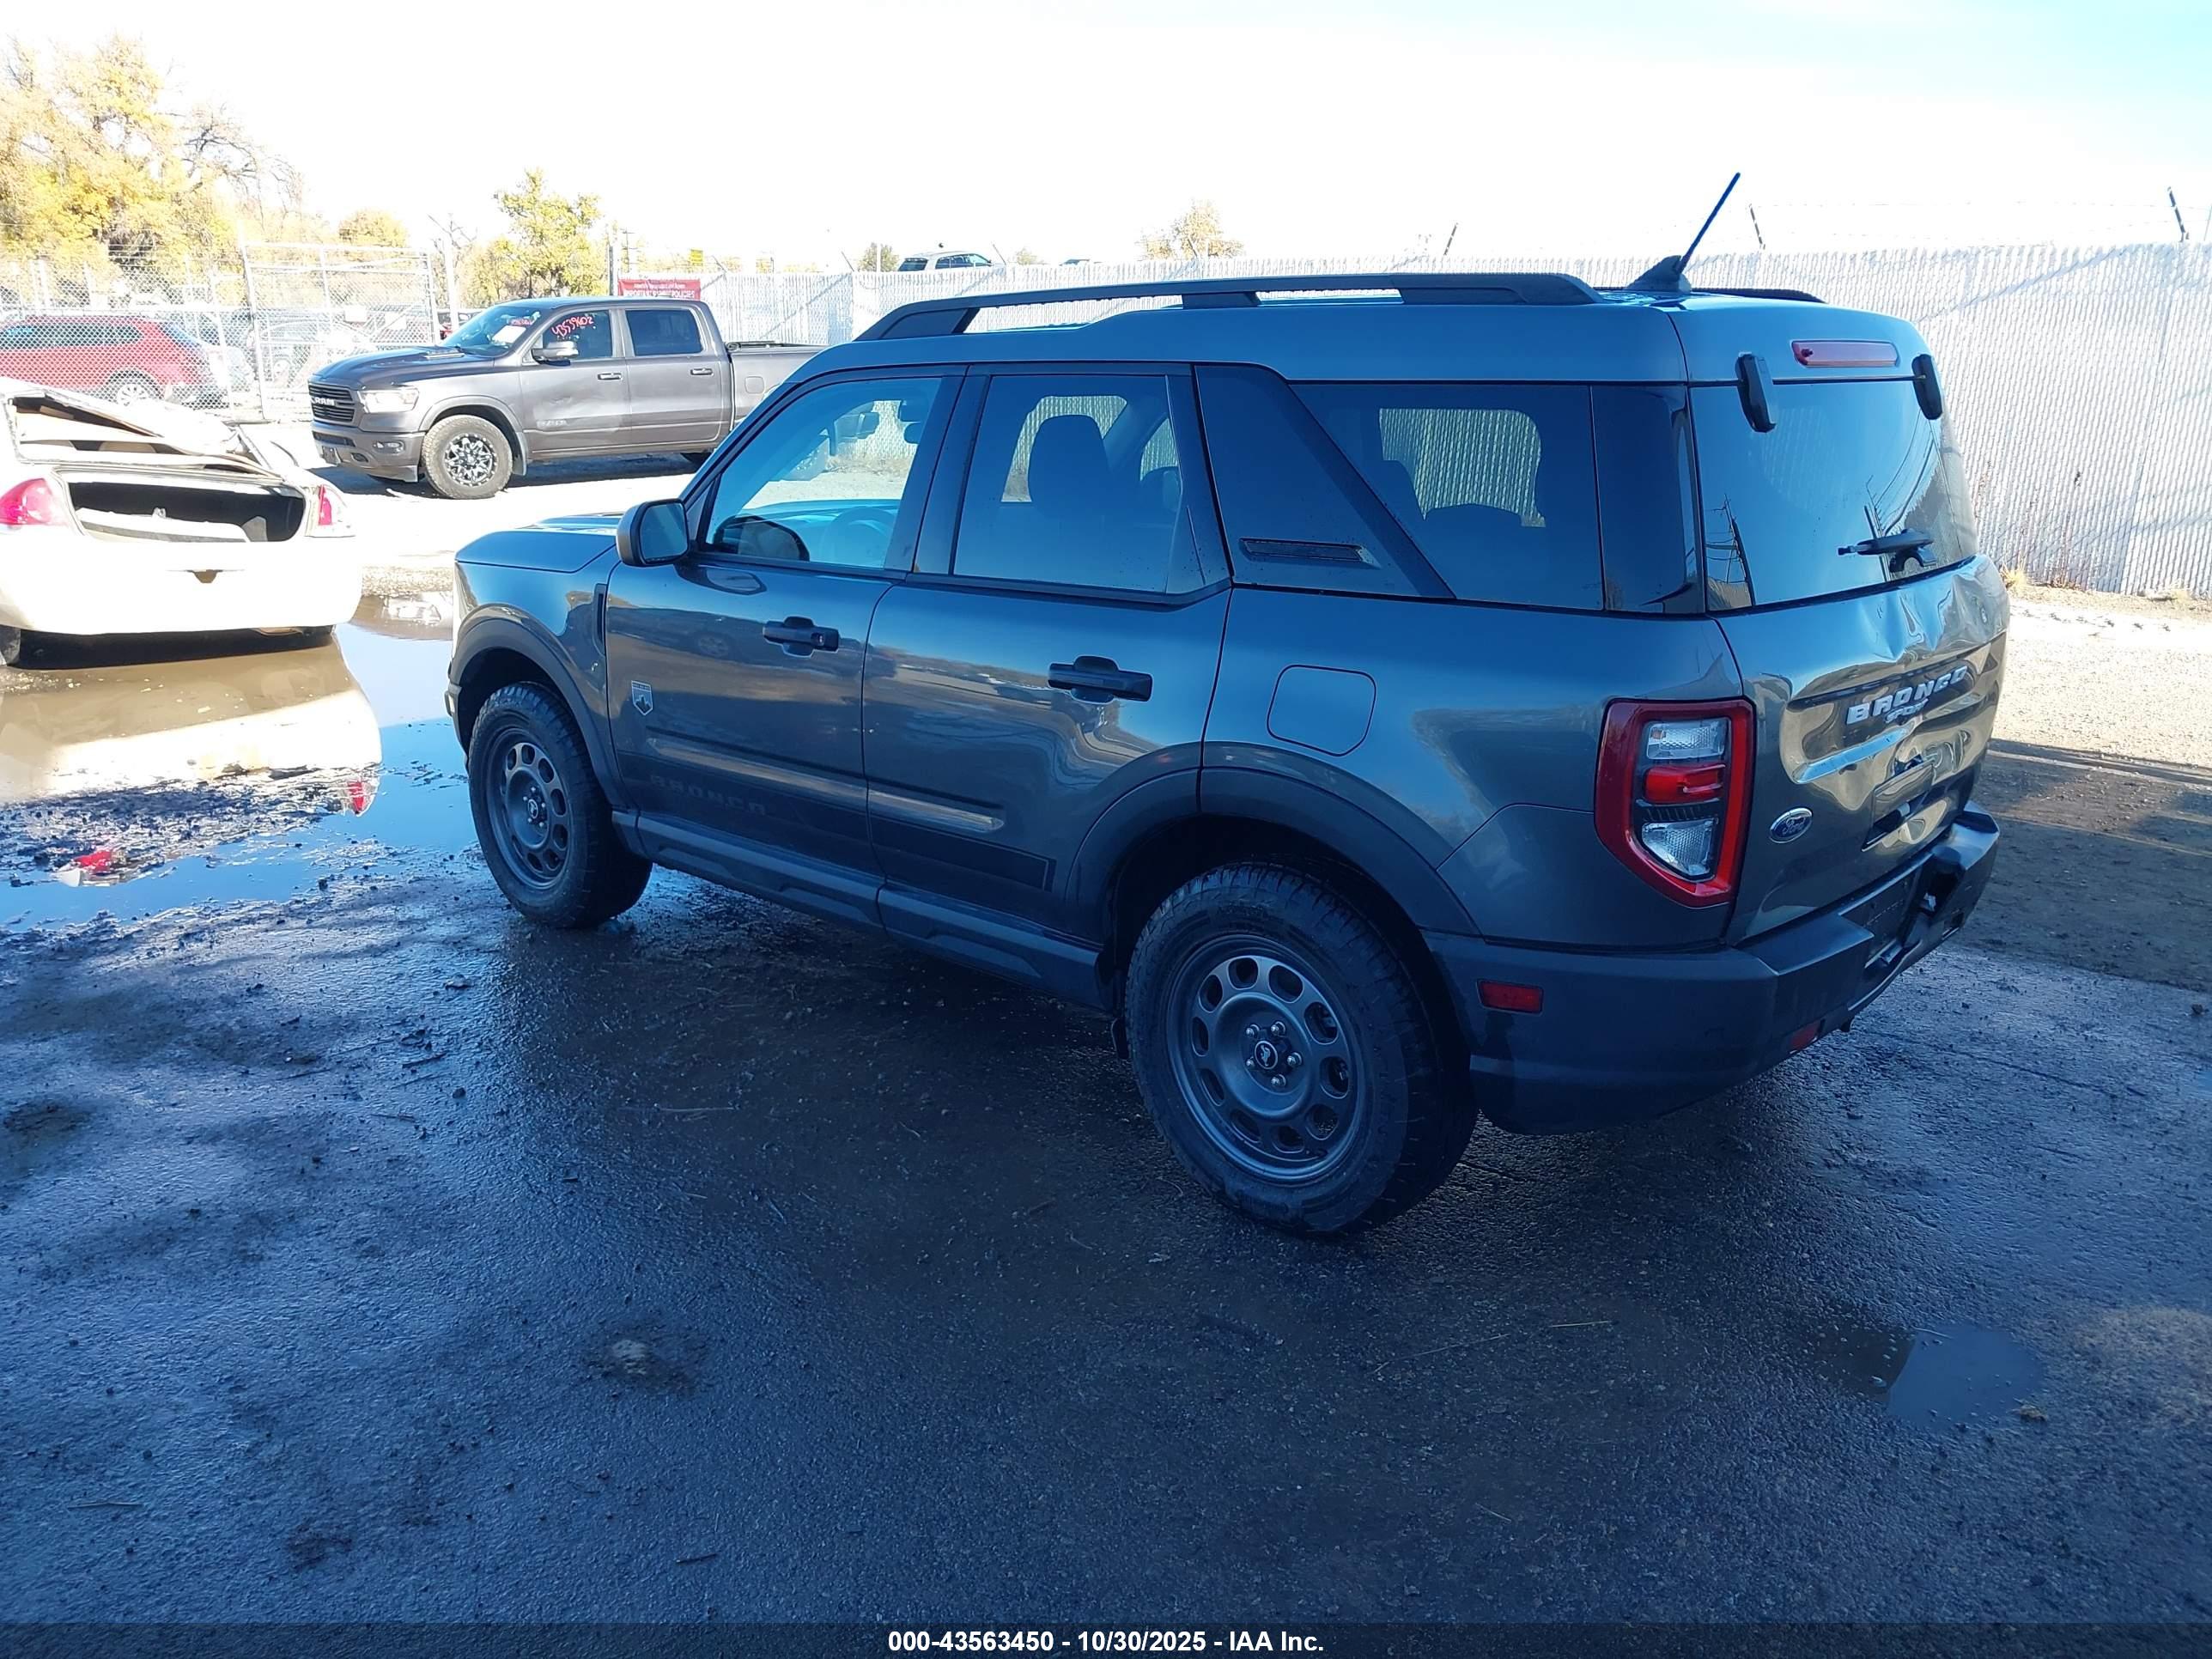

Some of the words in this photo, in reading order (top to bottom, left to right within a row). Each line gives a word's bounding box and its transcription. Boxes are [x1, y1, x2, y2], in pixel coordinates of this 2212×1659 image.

[314, 397, 336, 406] RAM
[1846, 665, 1968, 725] BRONCO
[1885, 699, 1929, 723] SPORT
